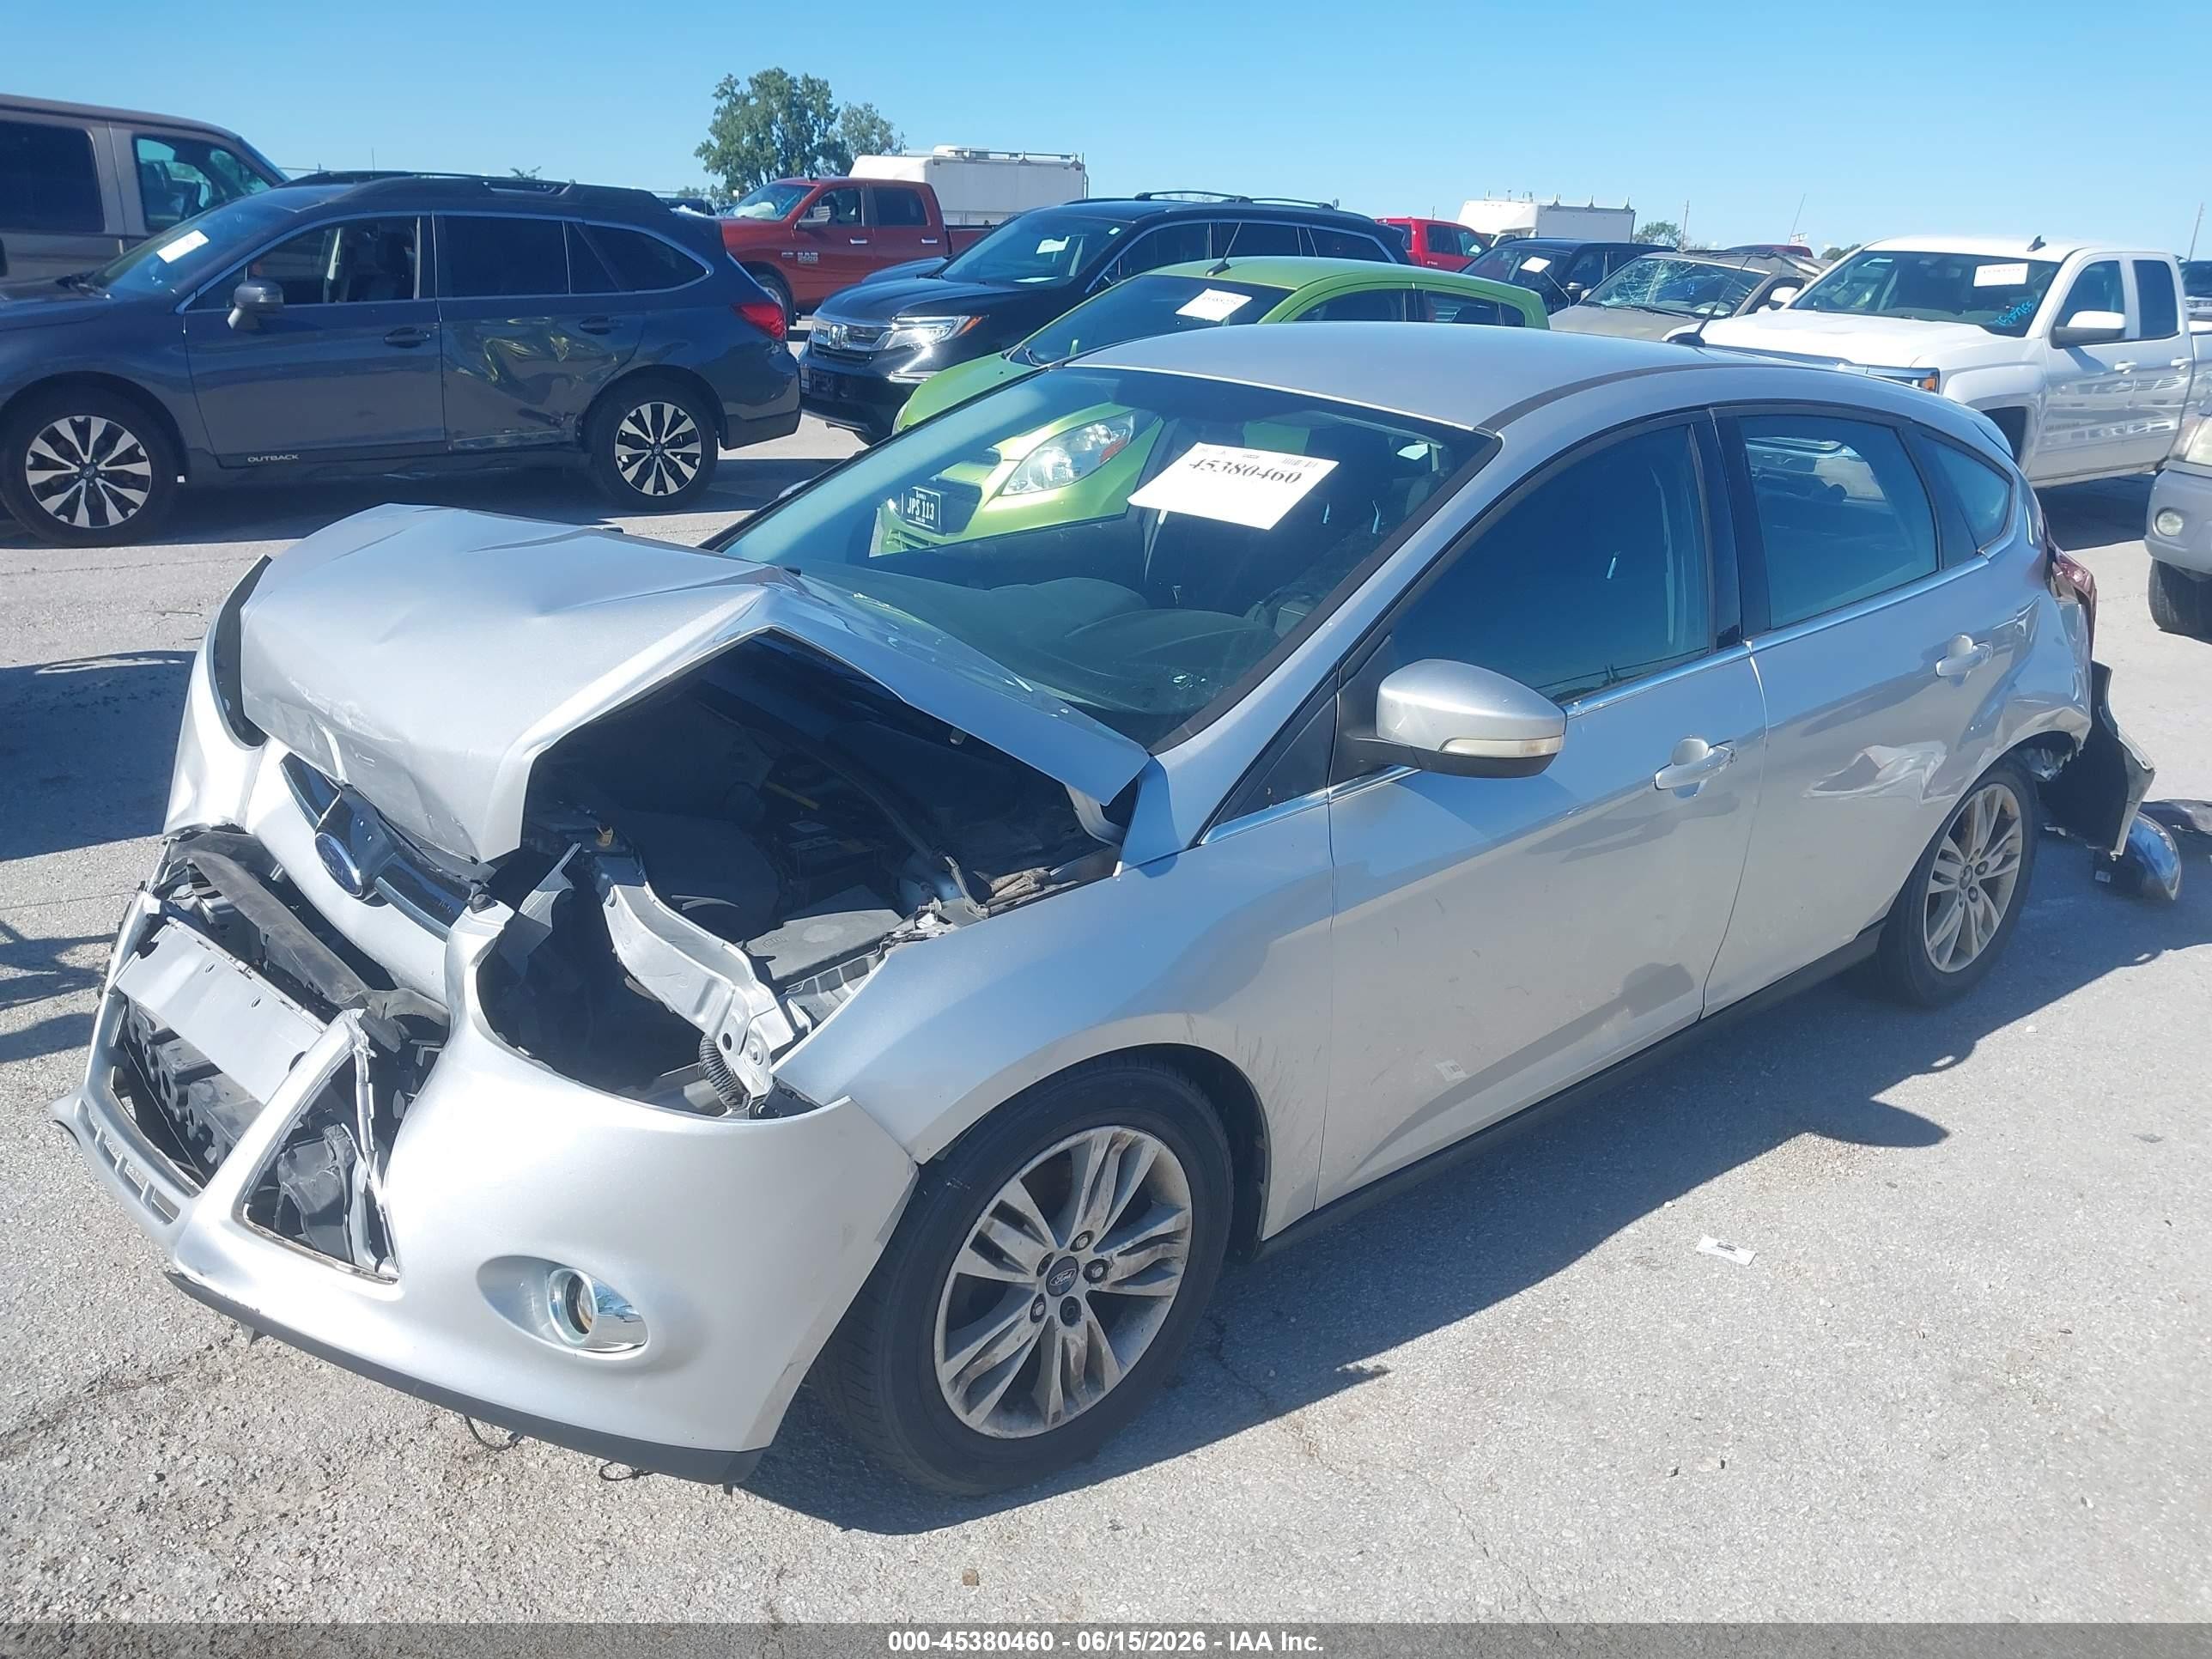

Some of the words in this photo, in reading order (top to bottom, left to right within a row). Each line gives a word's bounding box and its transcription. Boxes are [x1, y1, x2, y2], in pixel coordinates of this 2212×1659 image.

[247, 454, 299, 463] OUTBACK
[1188, 459, 1303, 484] 45380460
[907, 496, 921, 516] JPS
[921, 501, 935, 520] 113
